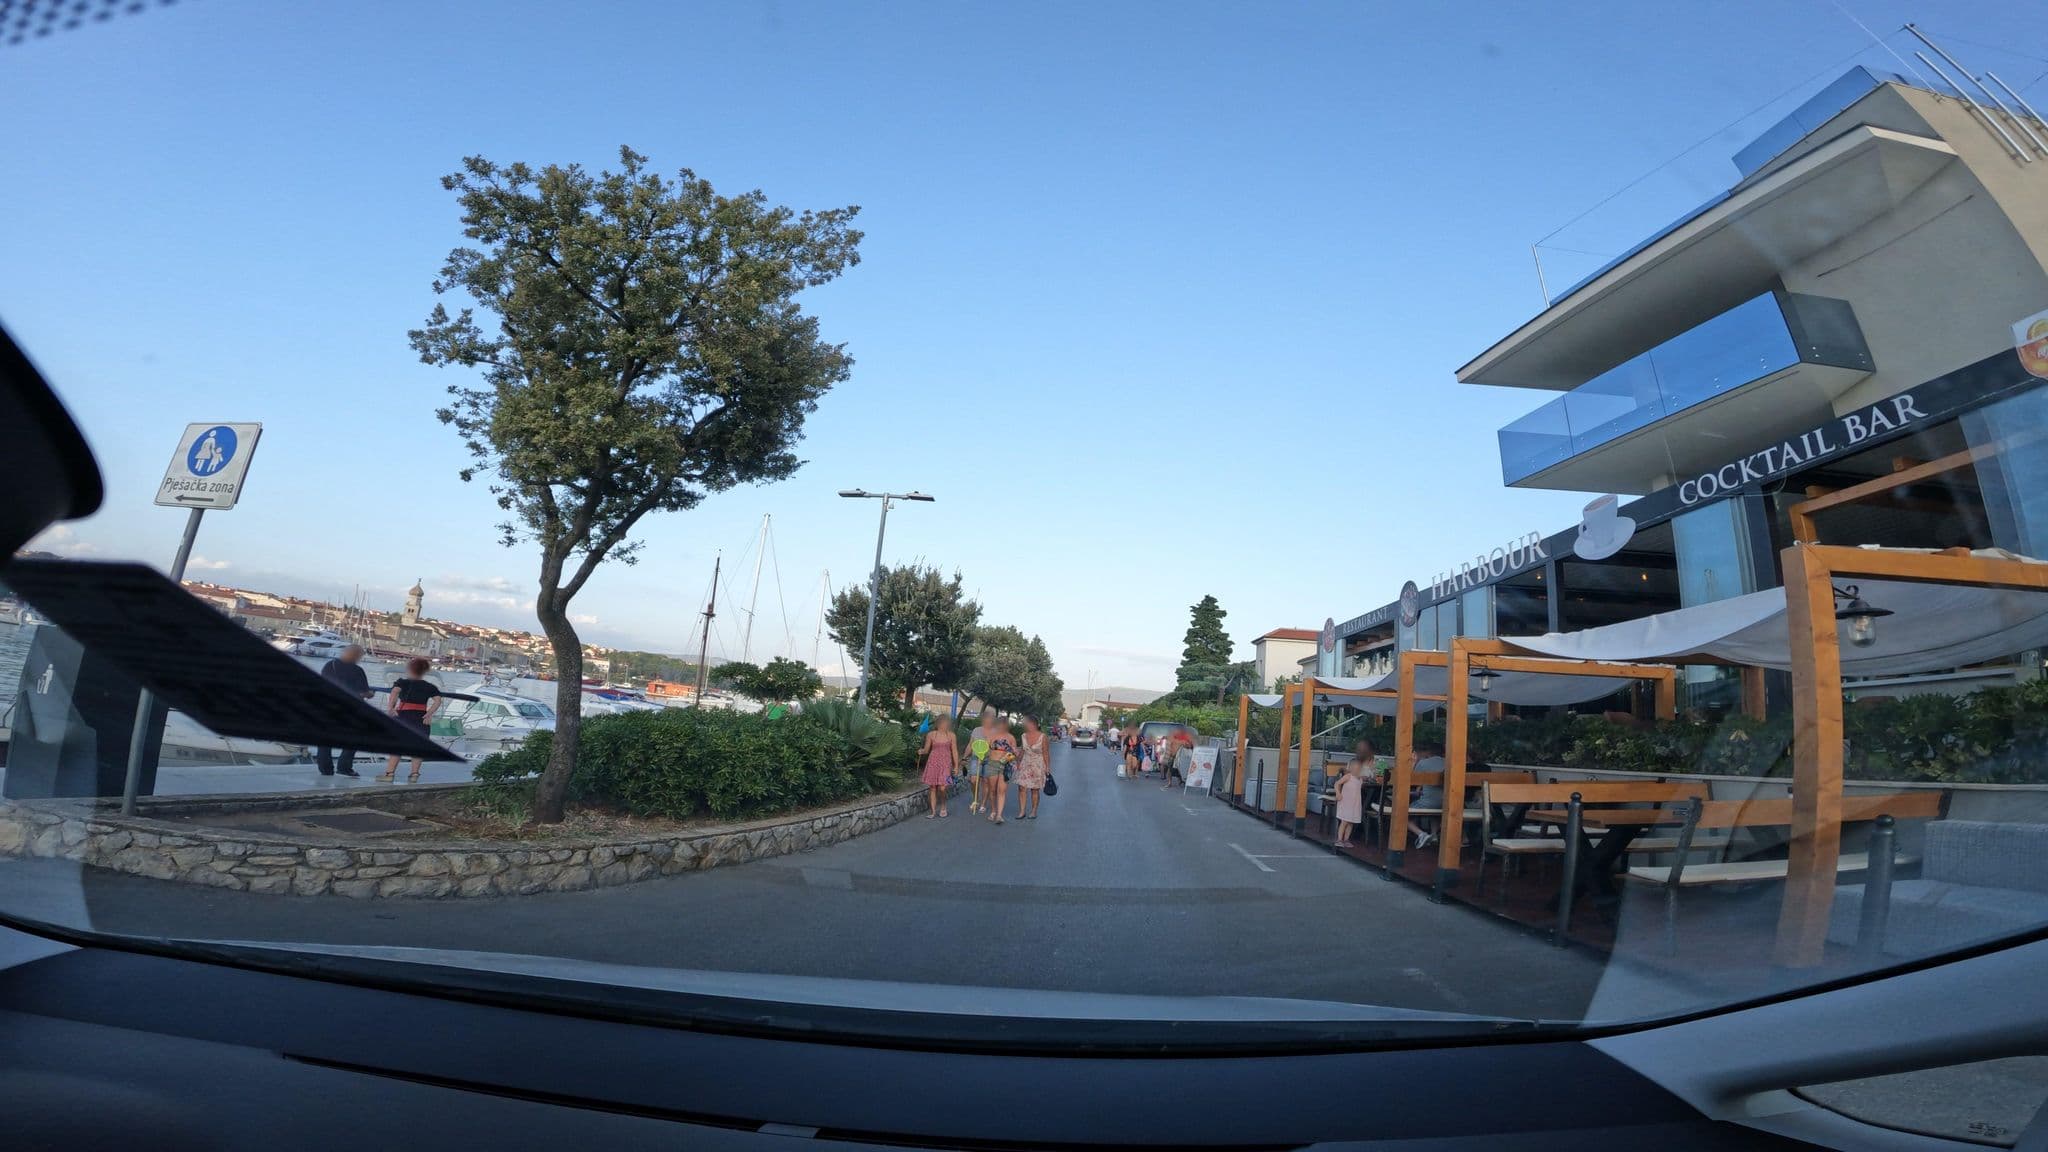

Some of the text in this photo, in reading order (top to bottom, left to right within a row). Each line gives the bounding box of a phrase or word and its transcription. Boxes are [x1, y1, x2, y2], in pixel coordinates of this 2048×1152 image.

[1679, 394, 1929, 505] COCKTAIL BAR
[163, 477, 235, 493] Pješačka zona
[1431, 530, 1549, 601] HARBOUR
[1342, 606, 1389, 633] RESTAURANT
